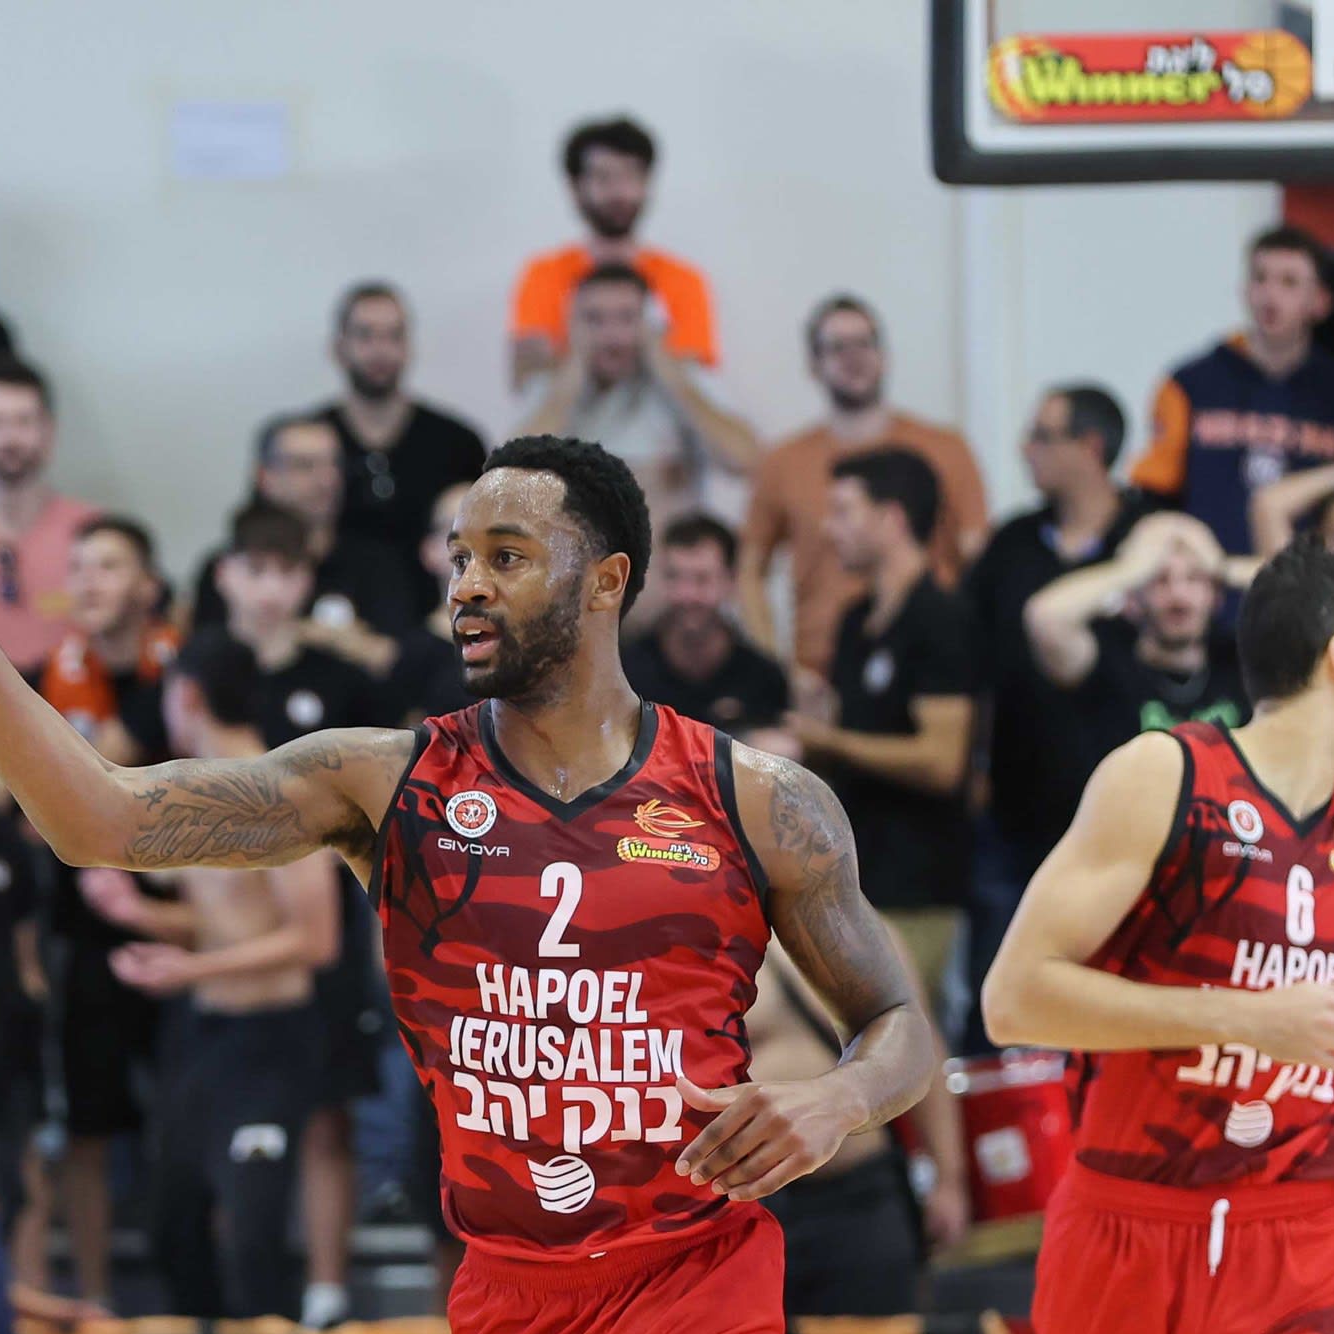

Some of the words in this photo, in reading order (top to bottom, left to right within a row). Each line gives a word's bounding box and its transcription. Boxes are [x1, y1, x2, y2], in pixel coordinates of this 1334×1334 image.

[1024, 53, 1220, 102] Winner
[438, 838, 510, 857] GIVOVA
[630, 843, 692, 862] Winner
[538, 861, 584, 957] 2
[1286, 864, 1315, 946] 6
[476, 963, 648, 1024] HAPOEL
[449, 1015, 683, 1083] JERUSALEM
[453, 1071, 547, 1141] יהב
[562, 1085, 683, 1154] בנק
